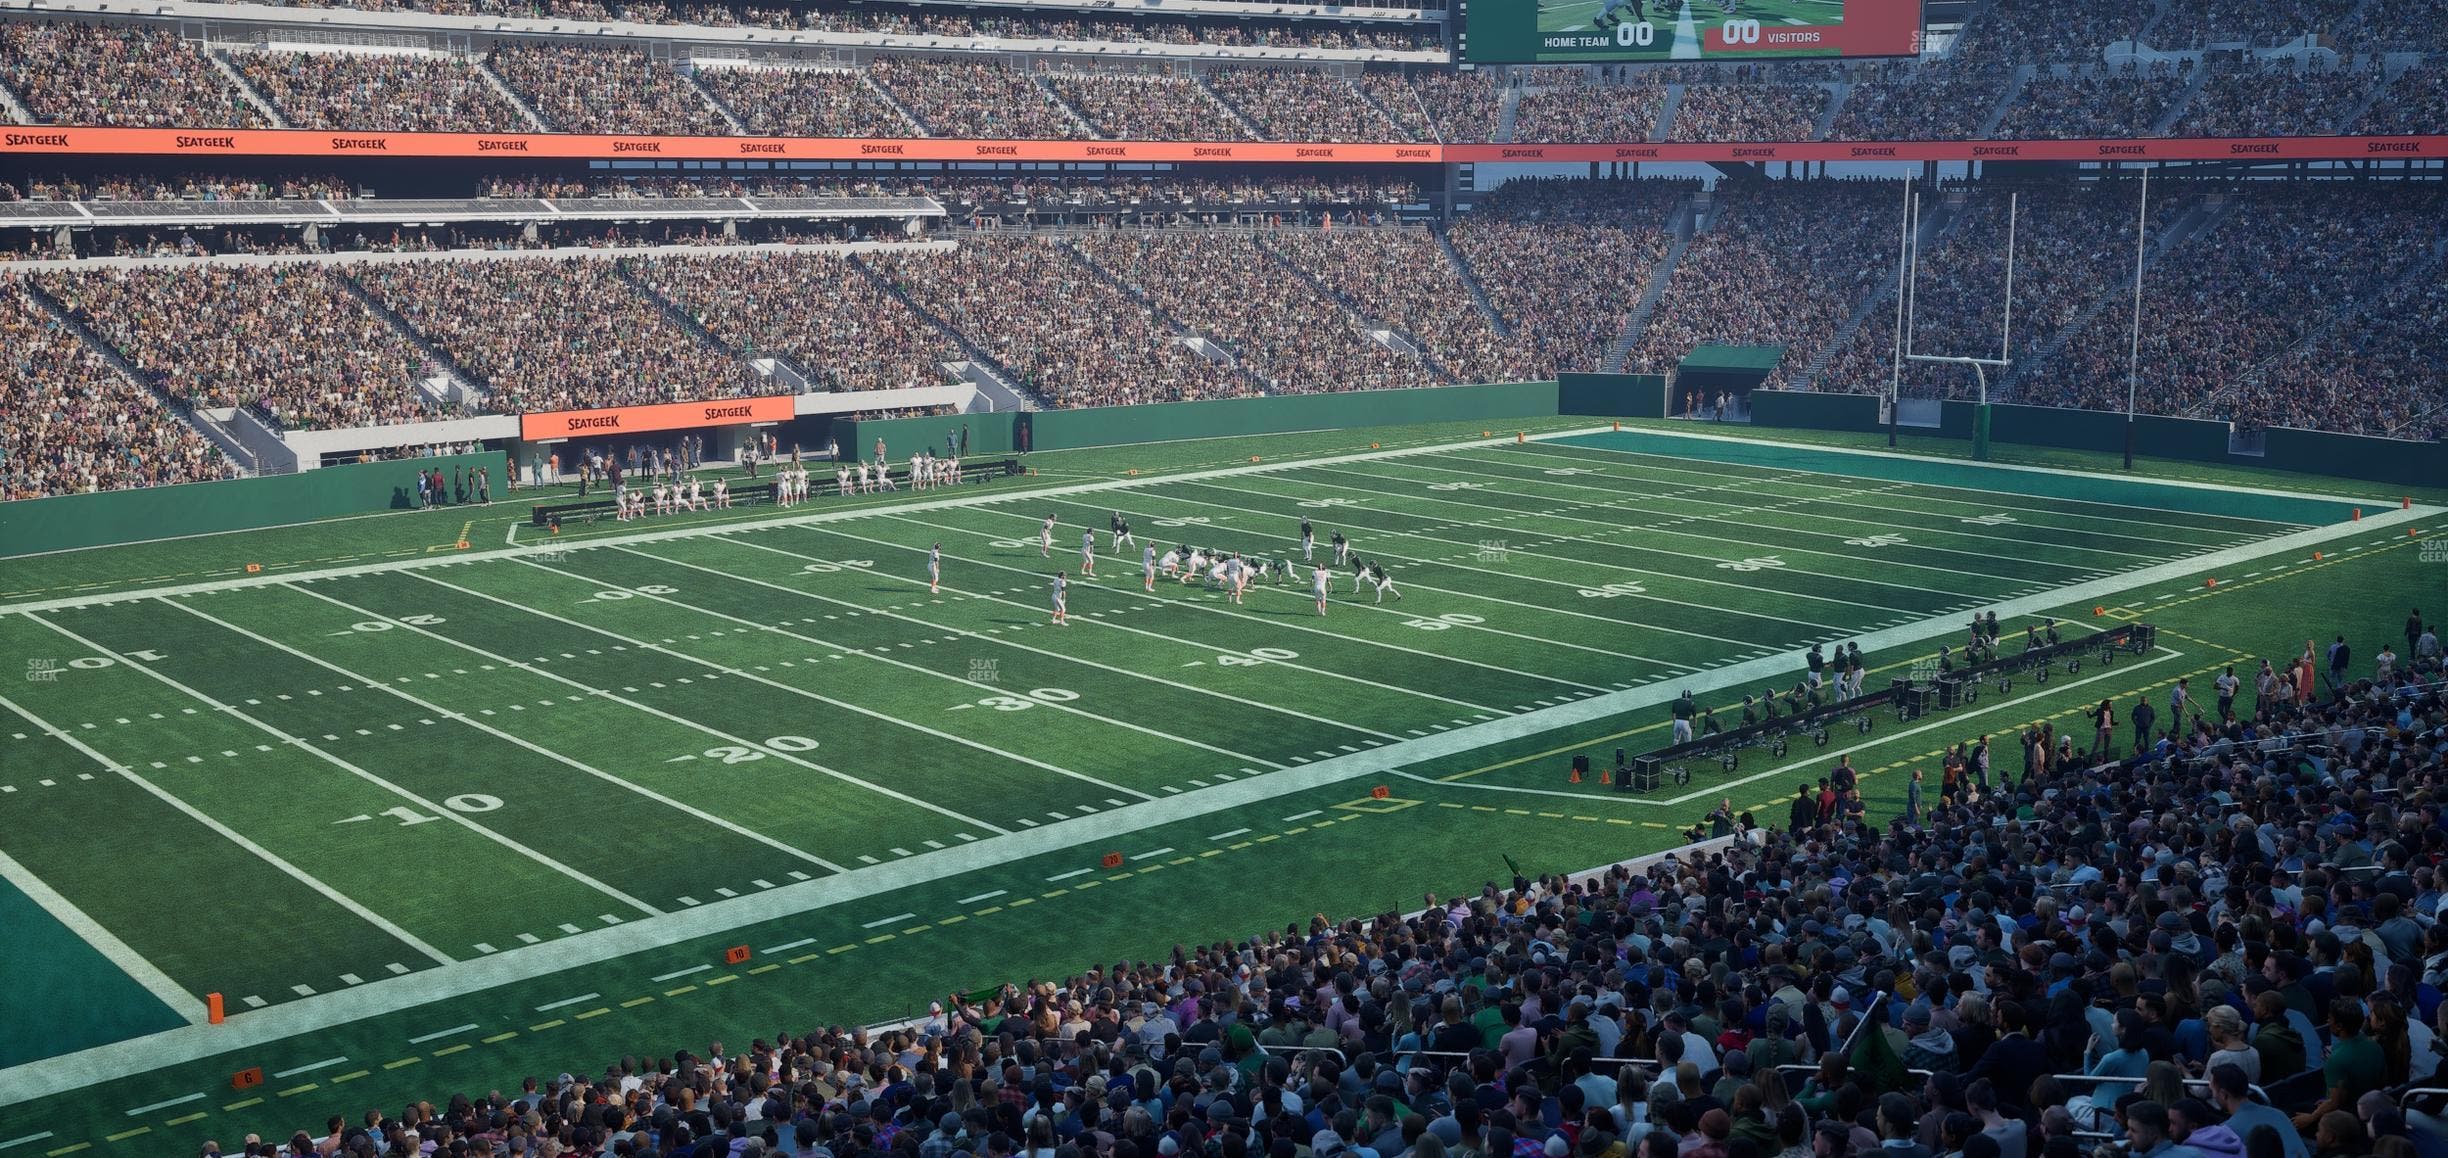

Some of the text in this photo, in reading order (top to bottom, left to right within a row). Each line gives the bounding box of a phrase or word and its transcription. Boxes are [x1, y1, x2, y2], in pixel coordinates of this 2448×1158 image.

[1544, 21, 1654, 47] HOME TEAM 00
[1722, 19, 1820, 44] 00 VISITORS
[5, 134, 1431, 158] SEATGEEK SEATGEEK SEATGEEK SEATGEEK SEATGEEK SEATGEEK SEATGEEK SEATGEEK SEATGEEK SEATGEEK SEATGEEK SEATGEEK
[567, 405, 752, 430] SEATGEEK SEATGEEK
[1400, 613, 1486, 631] 50
[1216, 647, 1300, 667] 40
[977, 687, 1080, 711] 30
[703, 735, 820, 764] 20
[379, 793, 504, 826] 10
